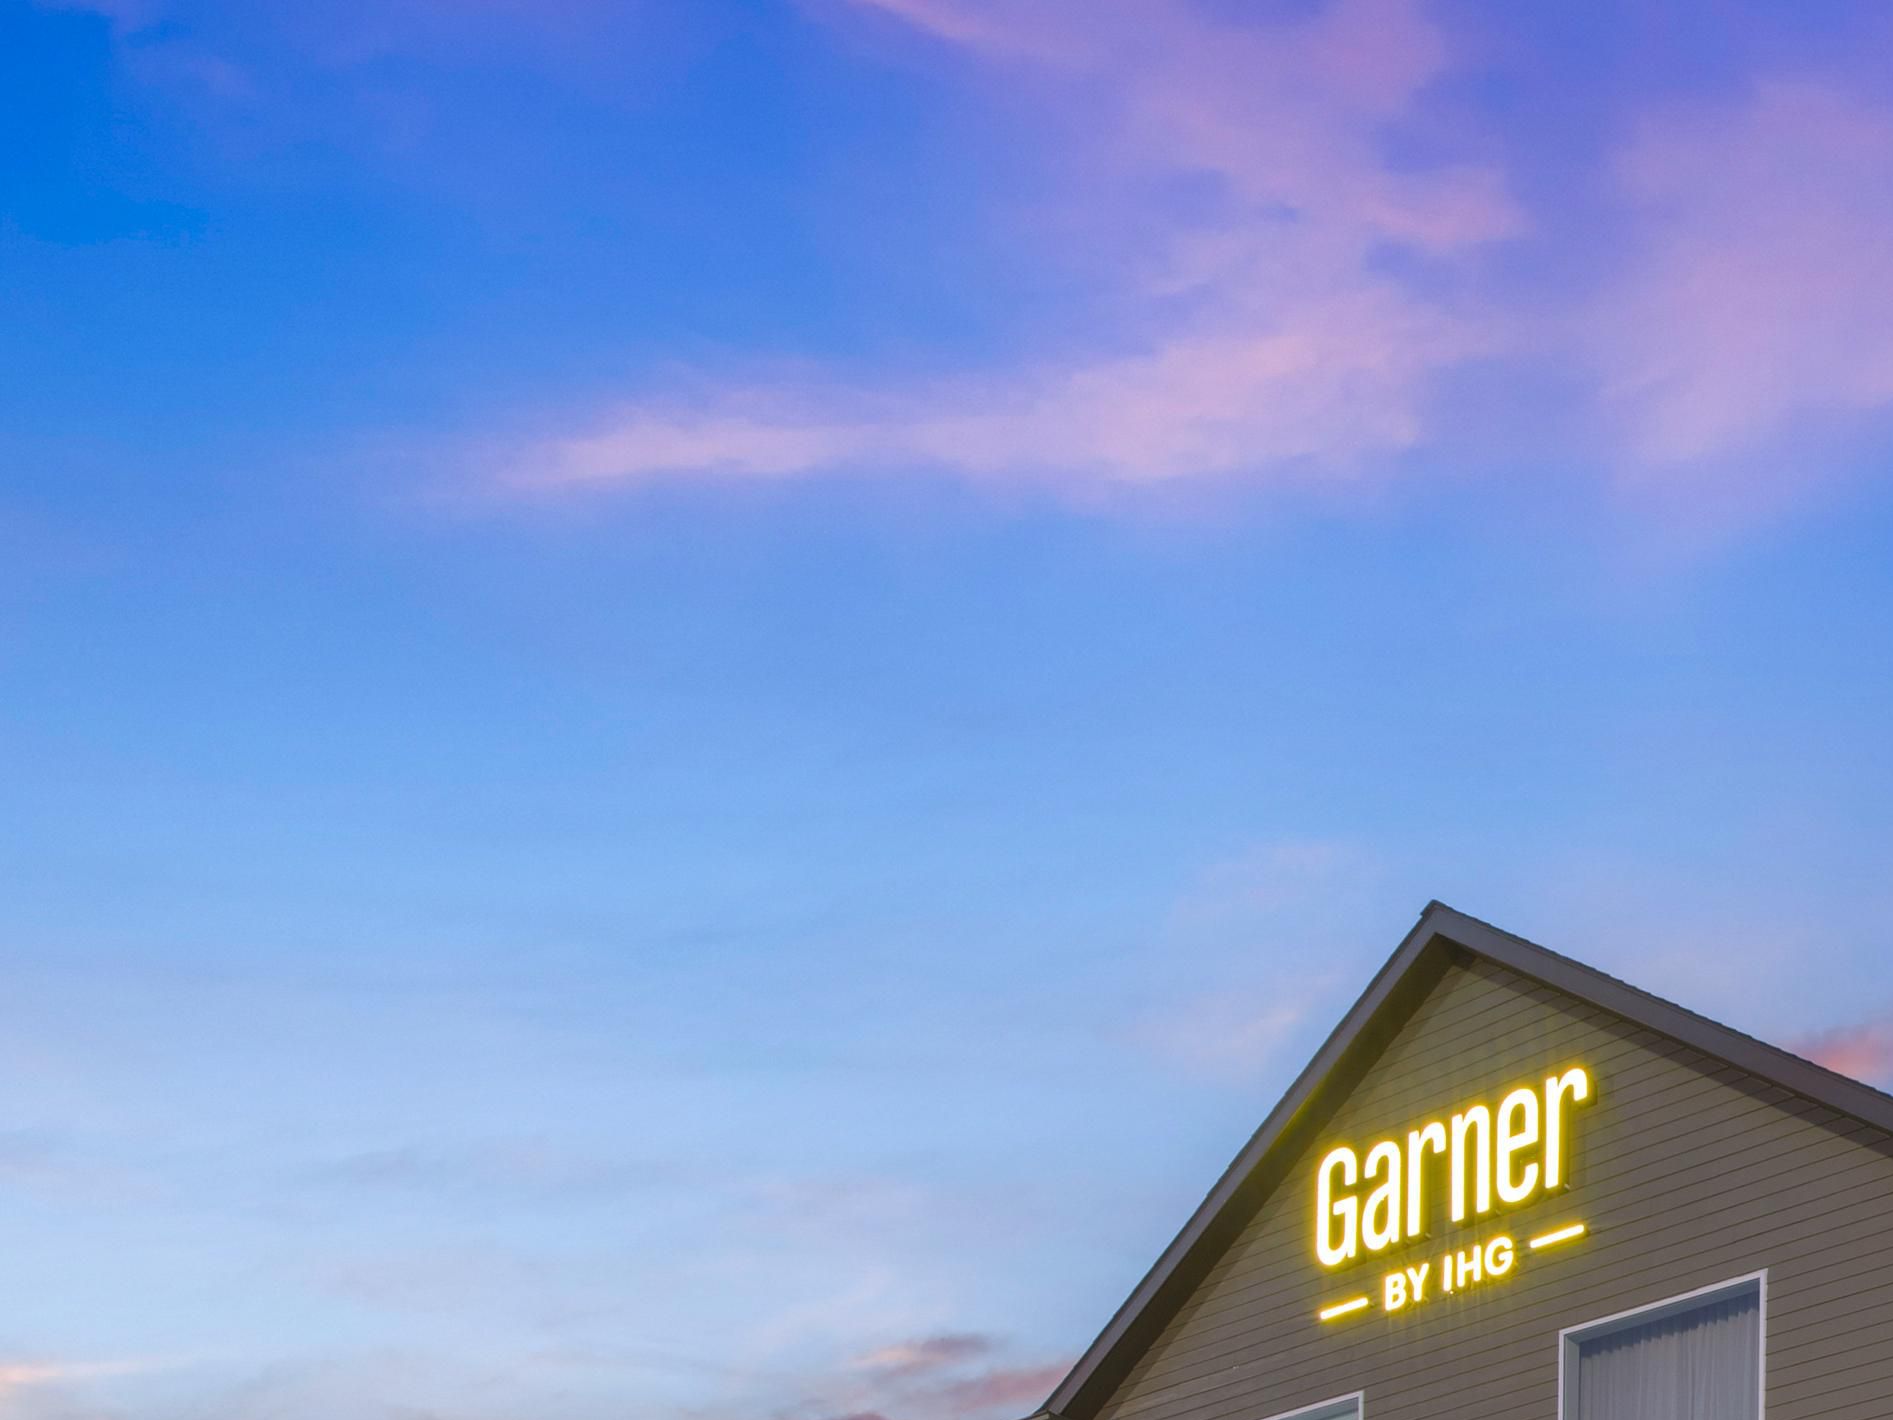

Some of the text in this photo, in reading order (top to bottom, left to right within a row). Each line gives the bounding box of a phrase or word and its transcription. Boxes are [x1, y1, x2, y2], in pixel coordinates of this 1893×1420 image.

[1315, 1067, 1588, 1267] Garner
[1384, 1236, 1514, 1312] BY IHG
